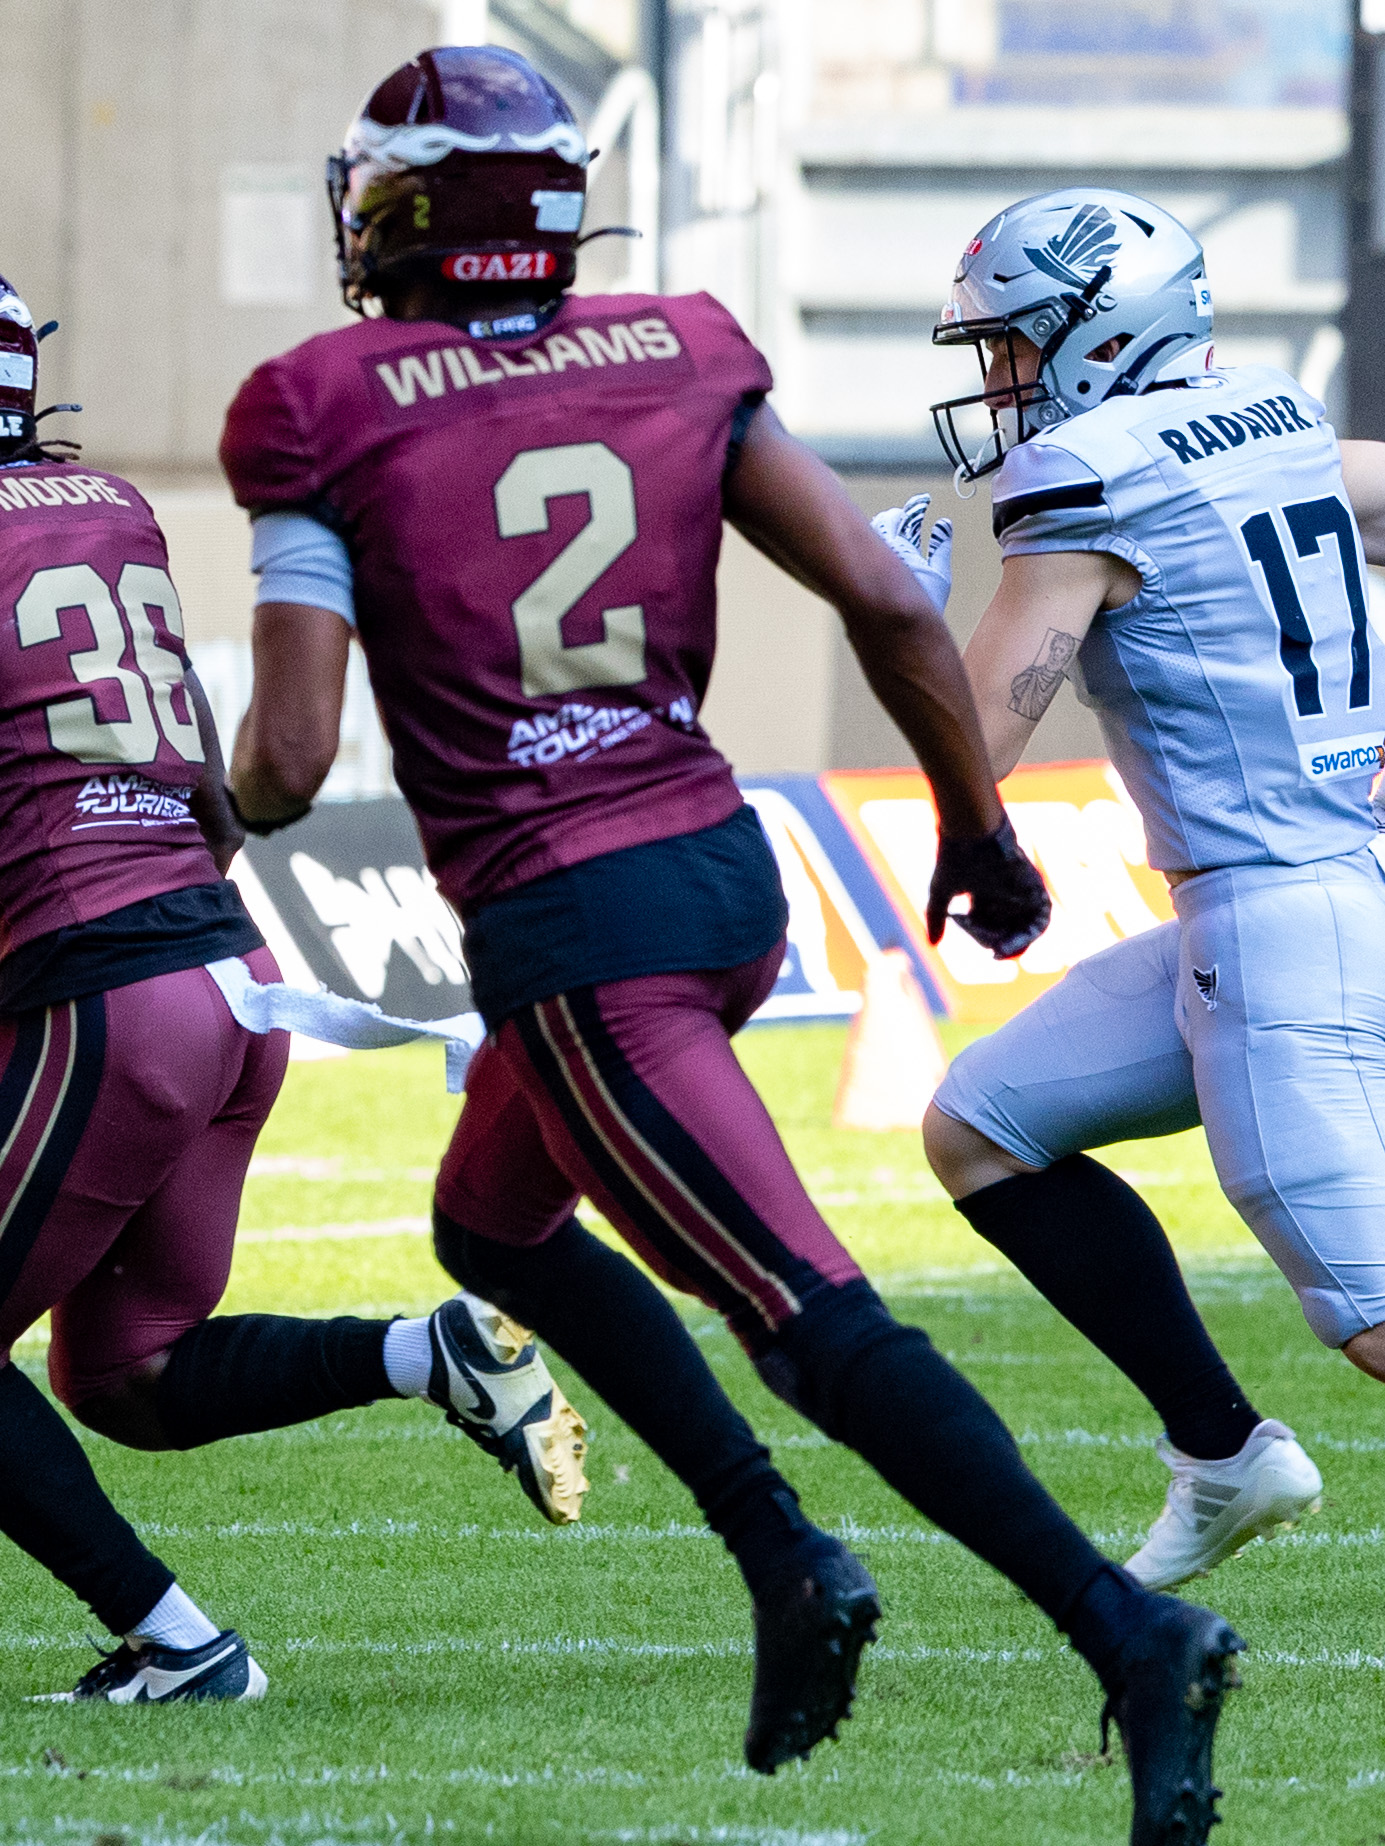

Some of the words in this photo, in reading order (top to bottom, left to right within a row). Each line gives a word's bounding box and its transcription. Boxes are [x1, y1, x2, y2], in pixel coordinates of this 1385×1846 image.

[413, 195, 430, 229] 2
[453, 250, 547, 281] GAZI
[1157, 395, 1314, 465] RADAUER
[493, 441, 648, 699] 2
[1236, 491, 1372, 721] 17
[1311, 746, 1377, 775] swarco
